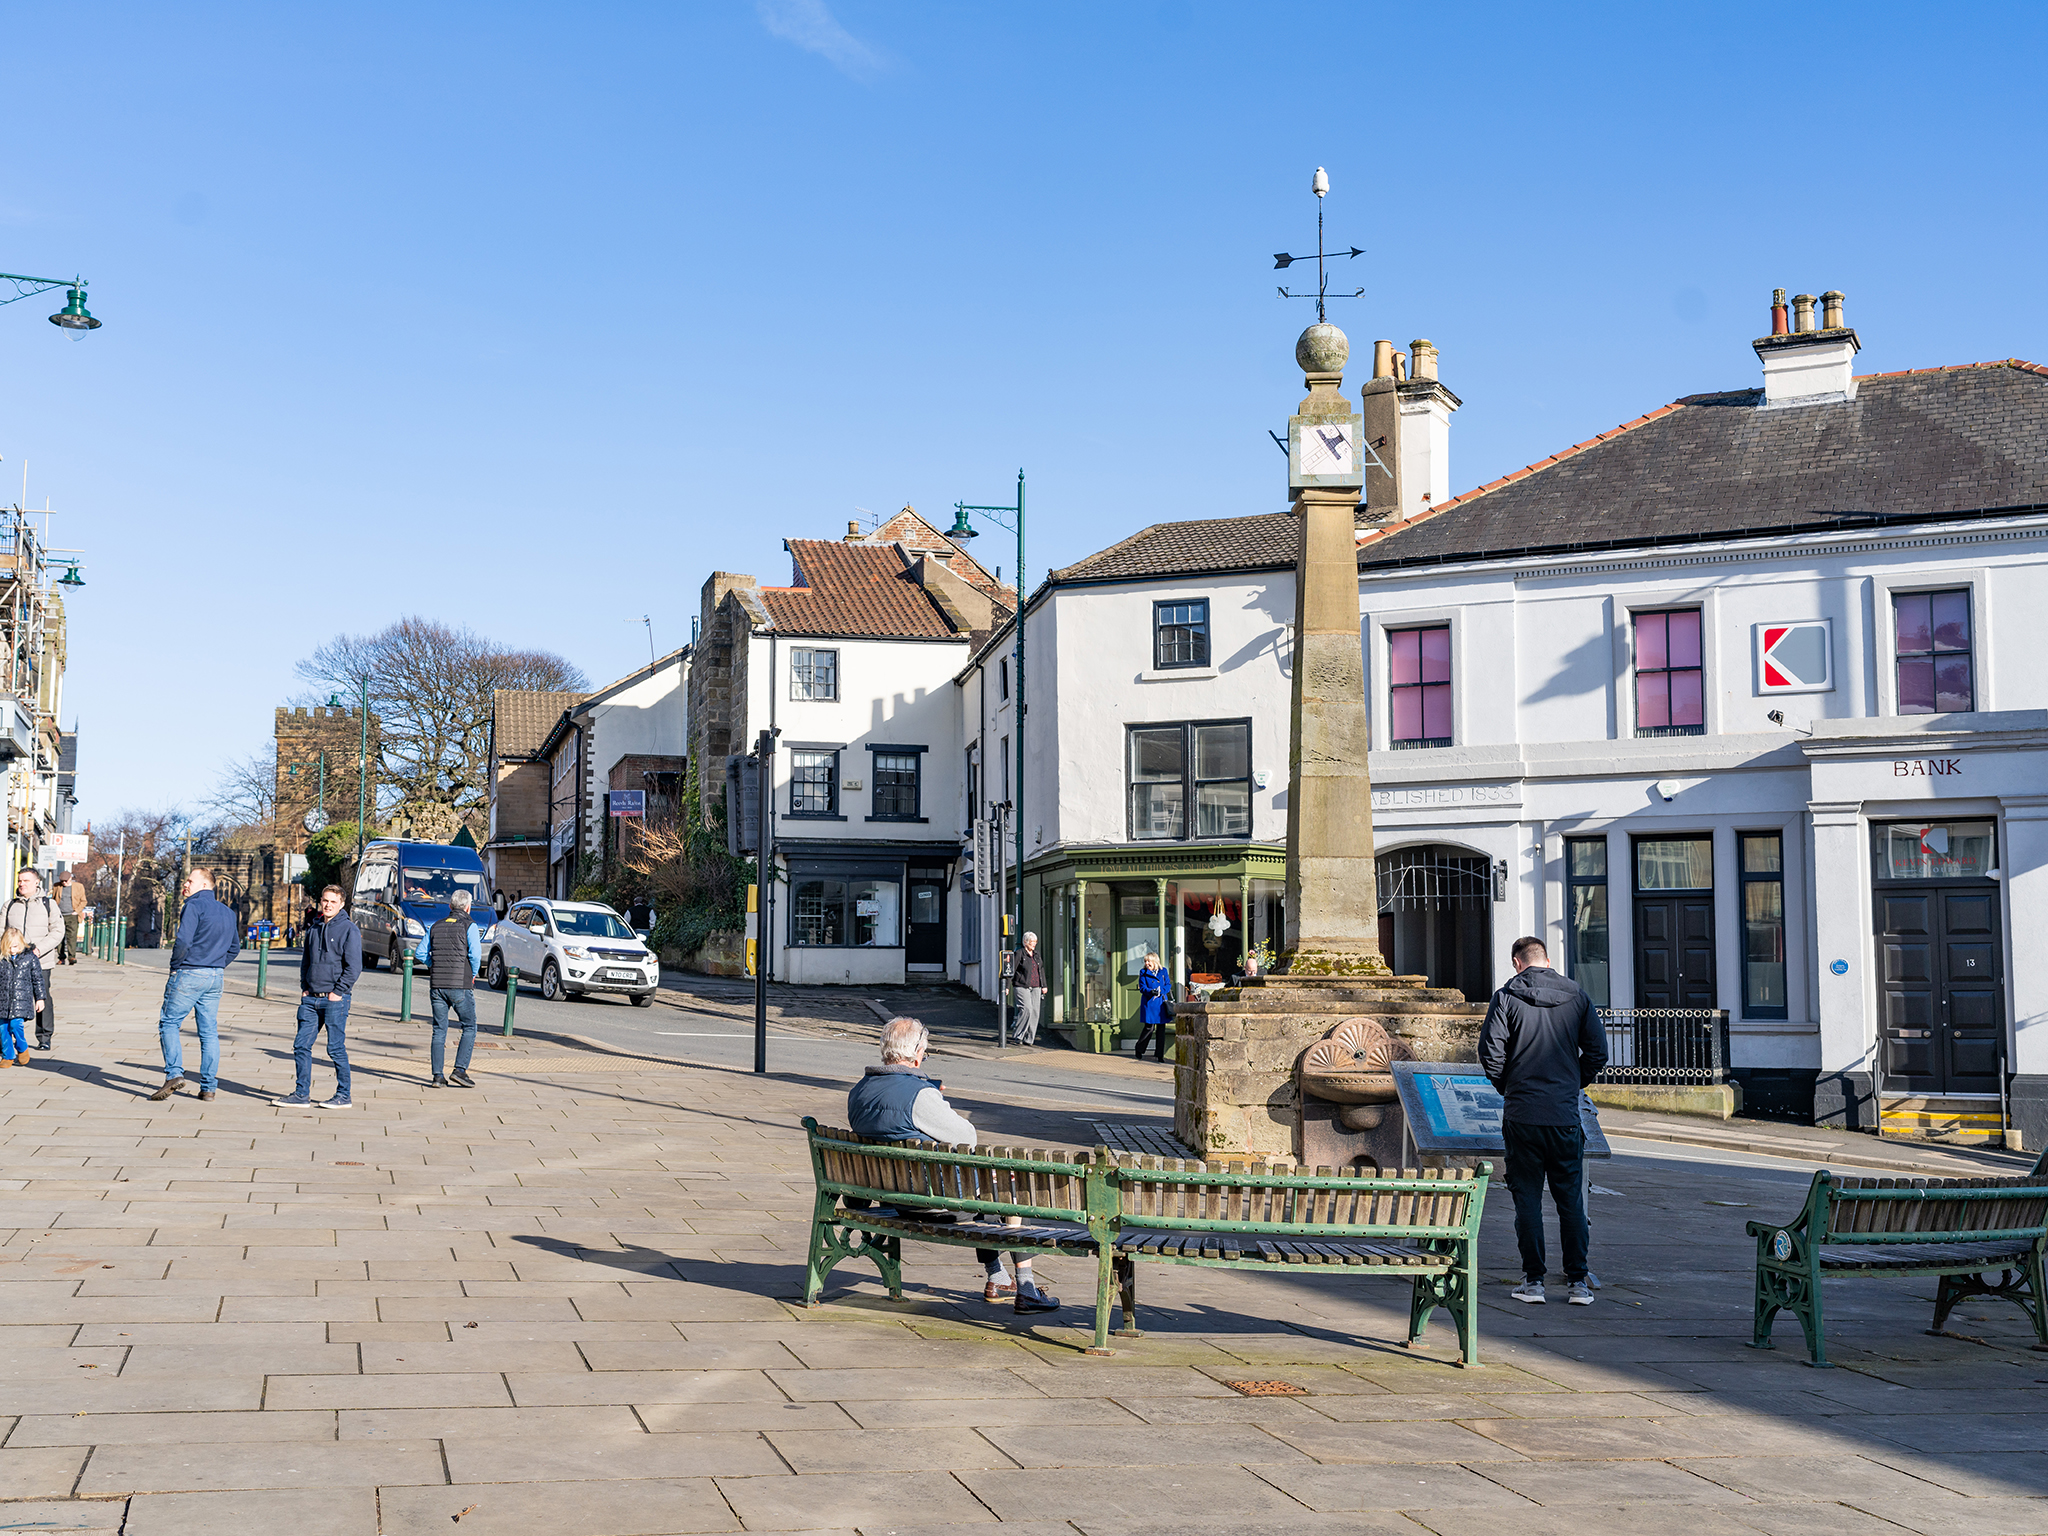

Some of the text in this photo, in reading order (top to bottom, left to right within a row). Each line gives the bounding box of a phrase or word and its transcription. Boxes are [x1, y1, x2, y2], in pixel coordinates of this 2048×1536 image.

[1277, 286, 1289, 298] N
[1894, 758, 1962, 777] BANK
[1471, 786, 1514, 801] 1833
[1895, 857, 1977, 867] KEVIN EDWARD
[1100, 863, 1219, 874] LOVE ALL THINGS QUIRKY
[1966, 958, 1975, 967] 13
[1428, 1076, 1481, 1090] Market
